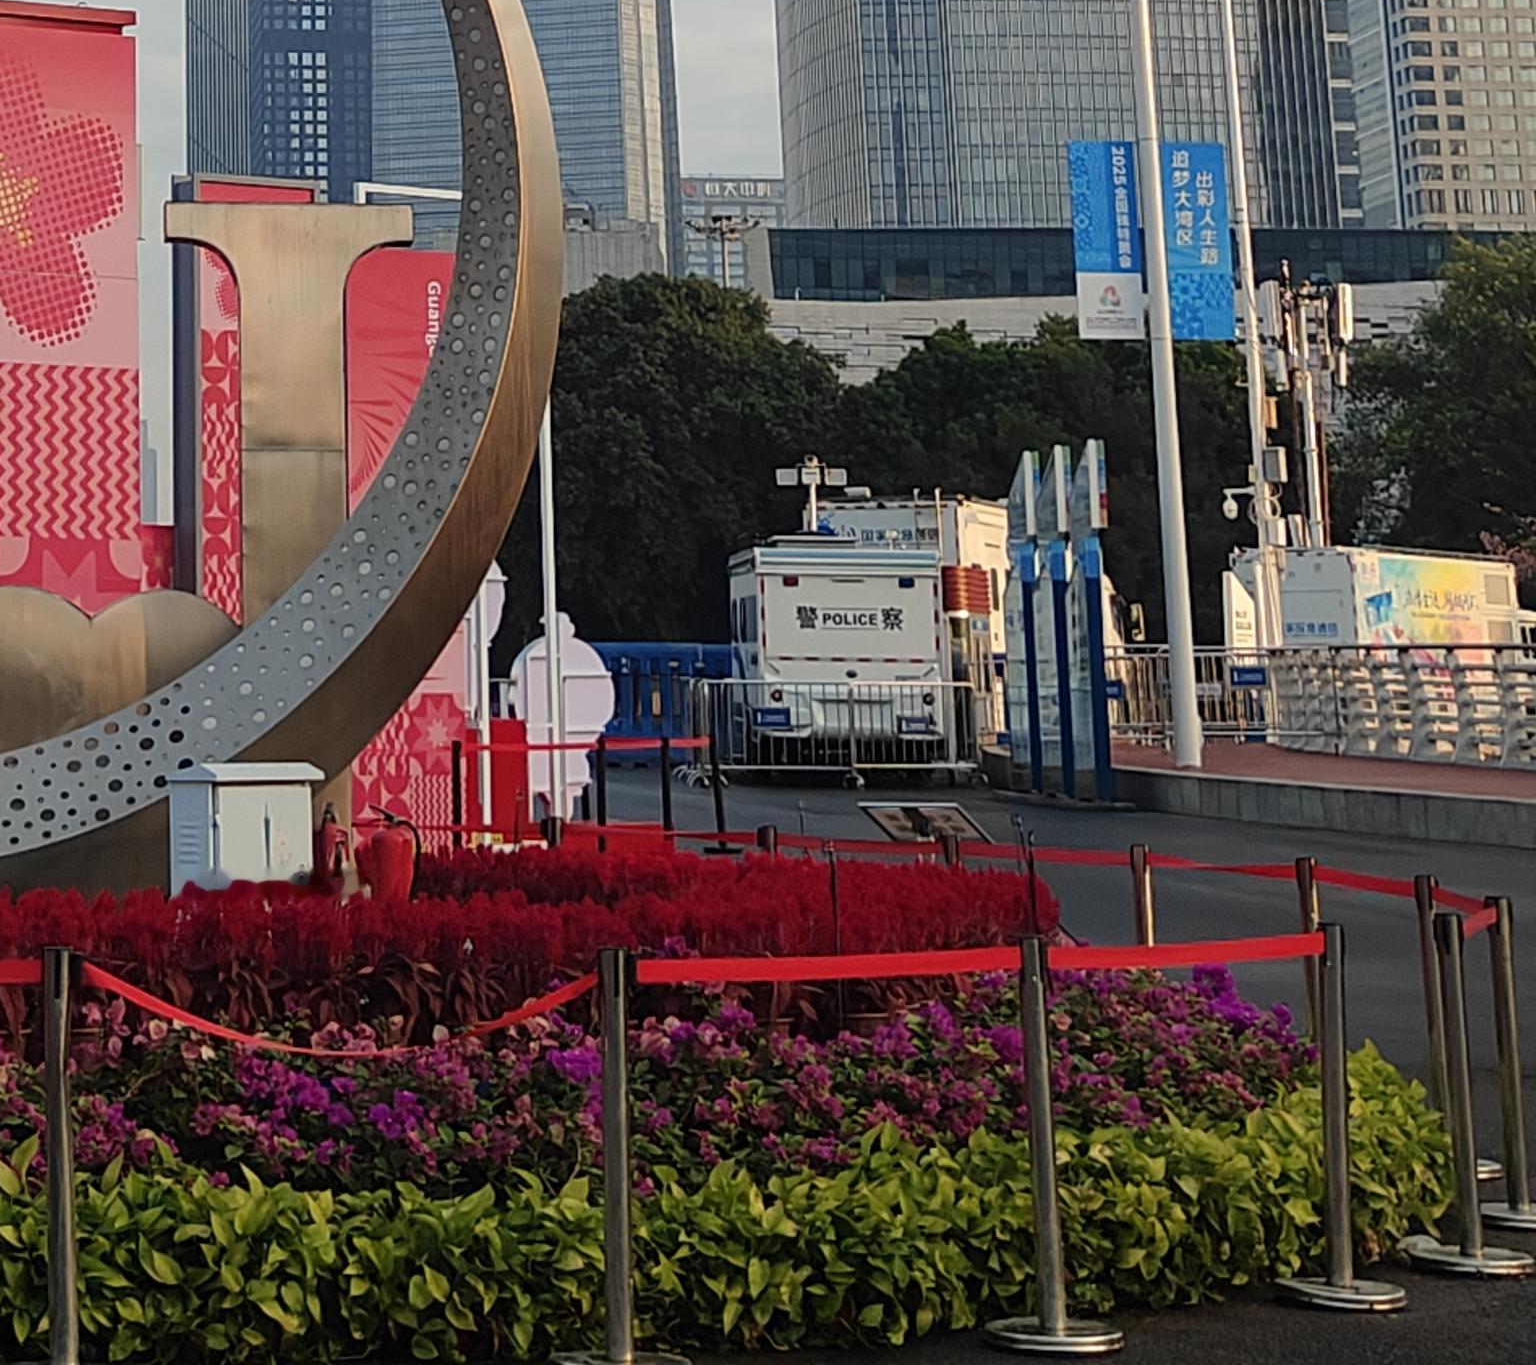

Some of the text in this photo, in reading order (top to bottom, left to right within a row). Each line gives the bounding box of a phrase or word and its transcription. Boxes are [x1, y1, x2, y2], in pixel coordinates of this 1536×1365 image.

[1171, 150, 1194, 246] 追梦大湾区
[1195, 171, 1219, 266] 出彩人生路
[796, 606, 904, 631] 警 POLICE 察
